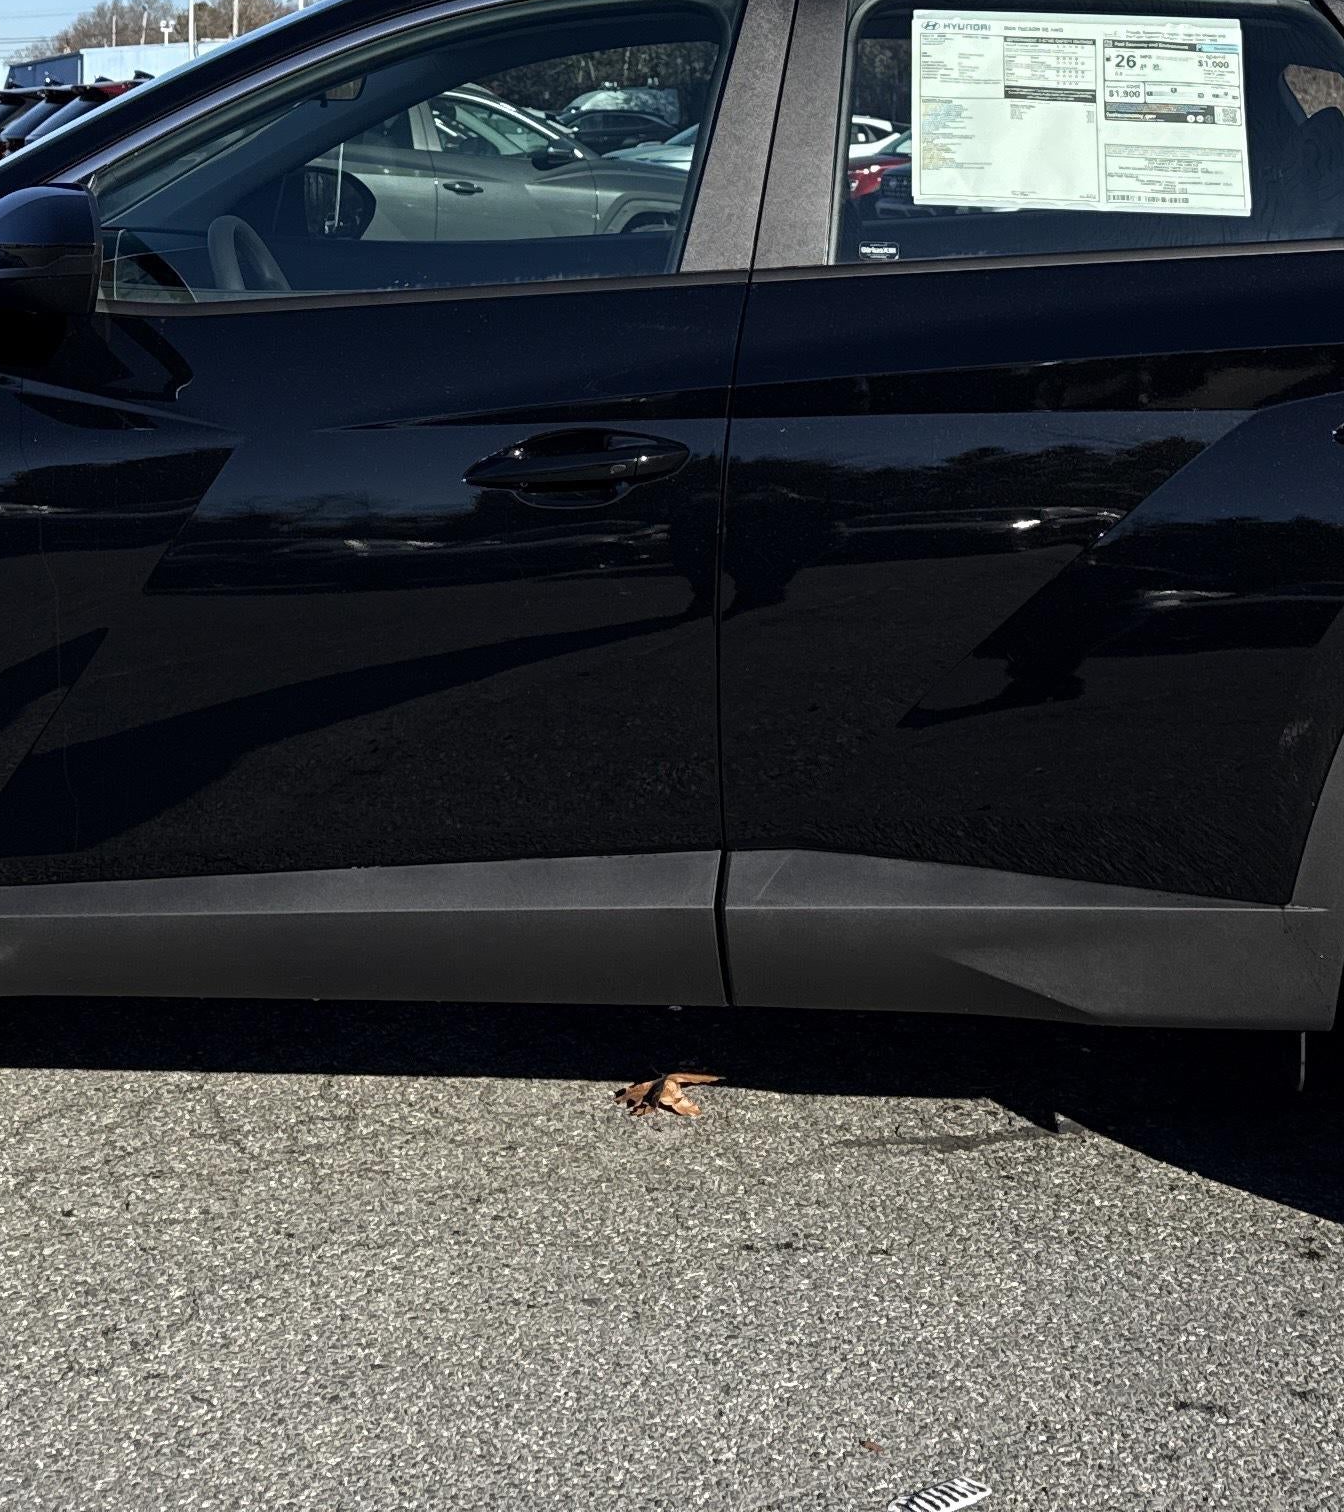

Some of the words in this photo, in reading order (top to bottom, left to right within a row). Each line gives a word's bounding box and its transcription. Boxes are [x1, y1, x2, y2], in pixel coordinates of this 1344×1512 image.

[943, 23, 991, 32] HYUNDAI
[1115, 54, 1137, 69] 26
[1197, 59, 1229, 69] $1,000
